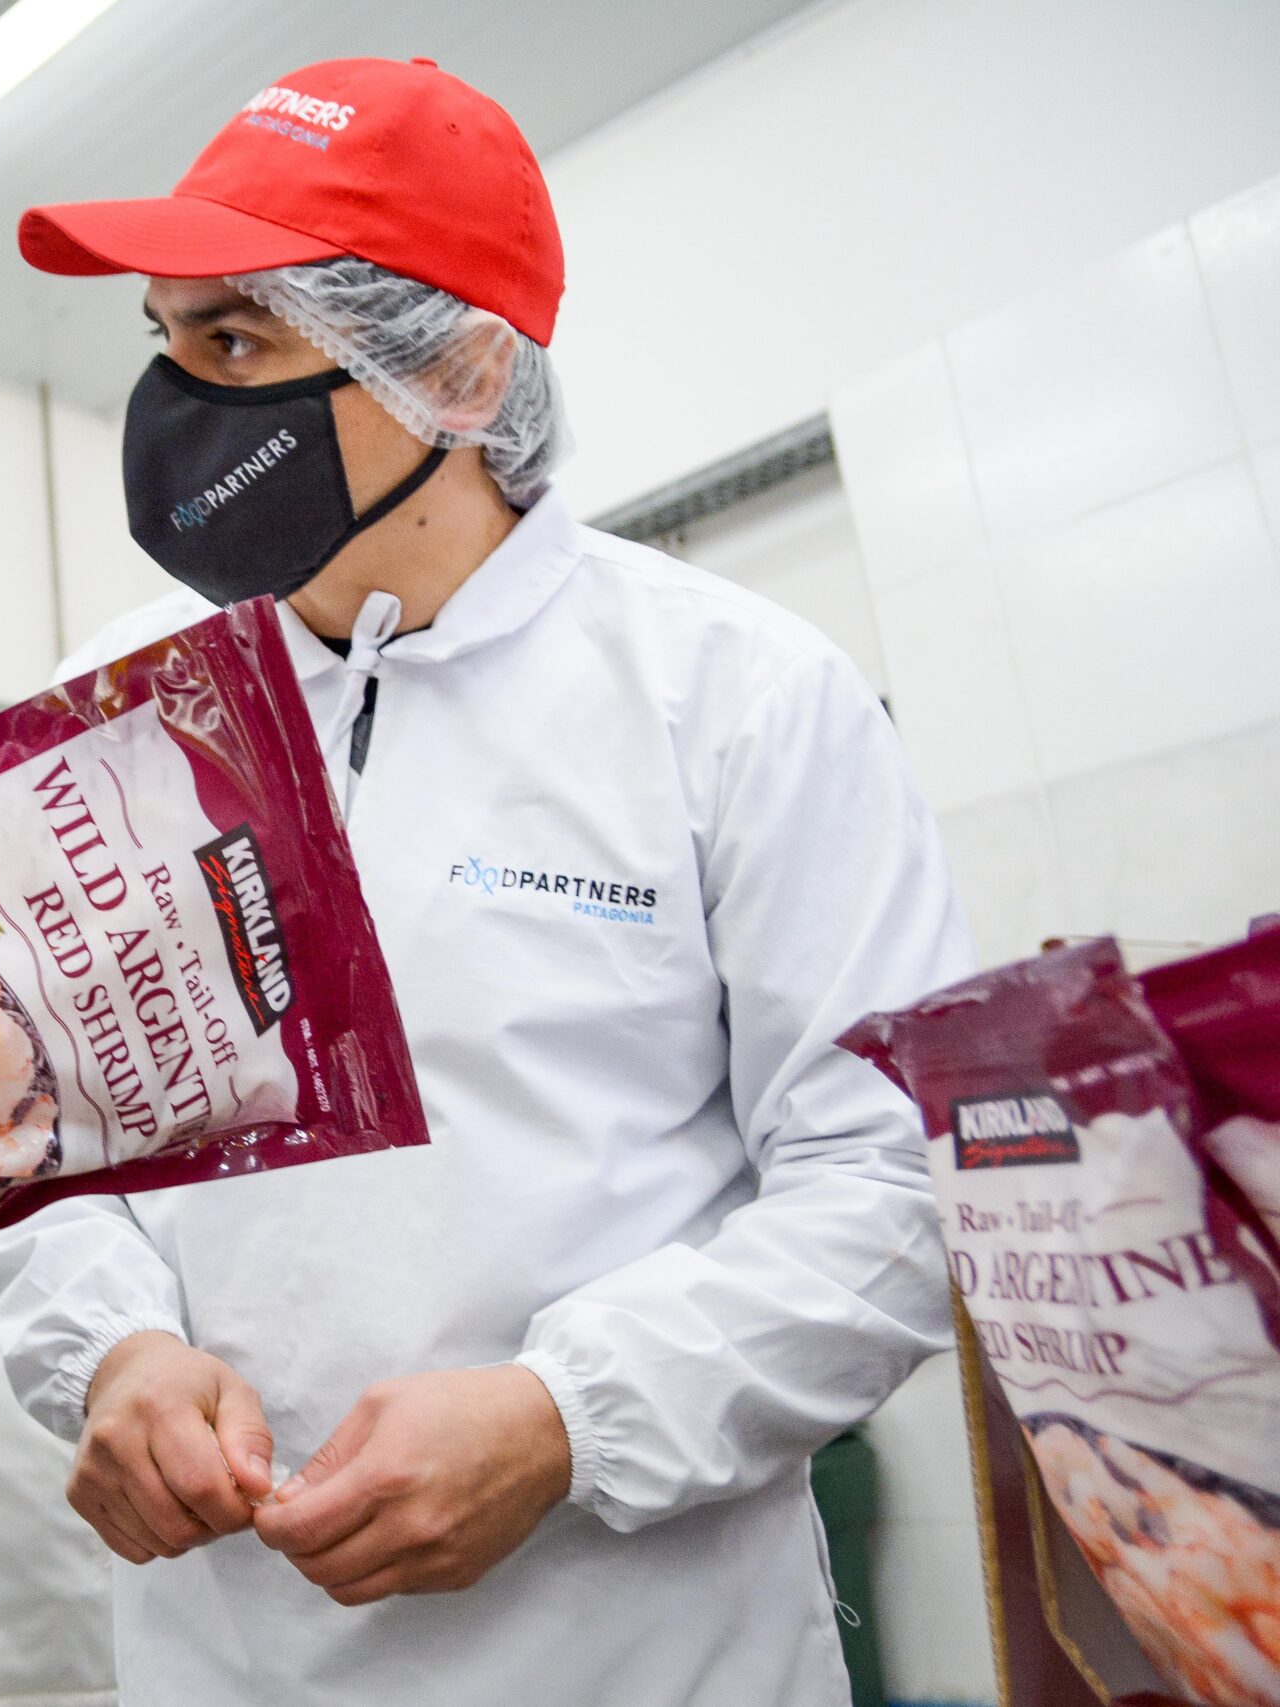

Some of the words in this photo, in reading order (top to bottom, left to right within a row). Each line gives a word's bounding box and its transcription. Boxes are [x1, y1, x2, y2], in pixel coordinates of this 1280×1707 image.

[170, 429, 298, 533] FOODPARTNERS
[32, 755, 128, 912] WILD
[449, 856, 657, 907] FOODPARTNERS
[141, 861, 183, 931] Raw
[179, 950, 239, 1069] Tail-Off
[199, 855, 266, 1027] Signature
[222, 836, 292, 1013] KIRKLAND
[572, 903, 655, 925] PATAGONIA
[22, 880, 94, 979] RED
[72, 983, 158, 1138] SHRIMP
[958, 1096, 1069, 1142] KIRKLAND
[988, 1231, 1239, 1307] ARGENTINE
